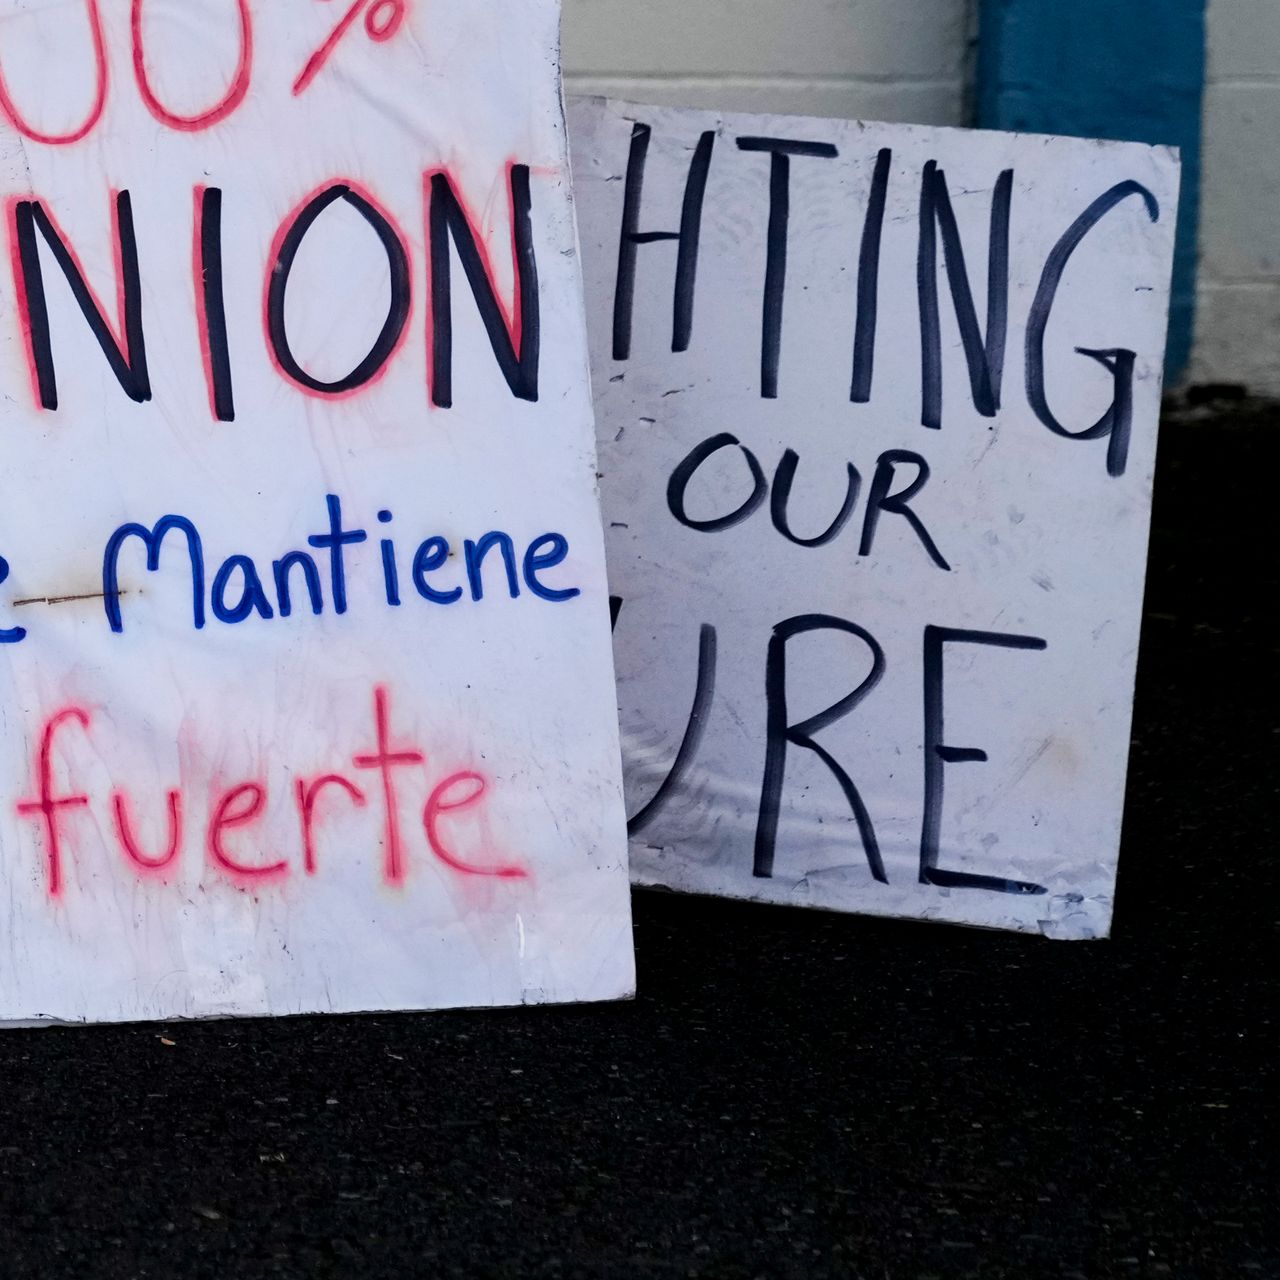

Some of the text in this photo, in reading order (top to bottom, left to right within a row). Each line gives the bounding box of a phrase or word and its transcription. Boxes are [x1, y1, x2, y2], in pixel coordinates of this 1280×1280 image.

[102, 493, 580, 633] Mantiene
[667, 433, 951, 571] OUR
[17, 684, 530, 897] fuerte
